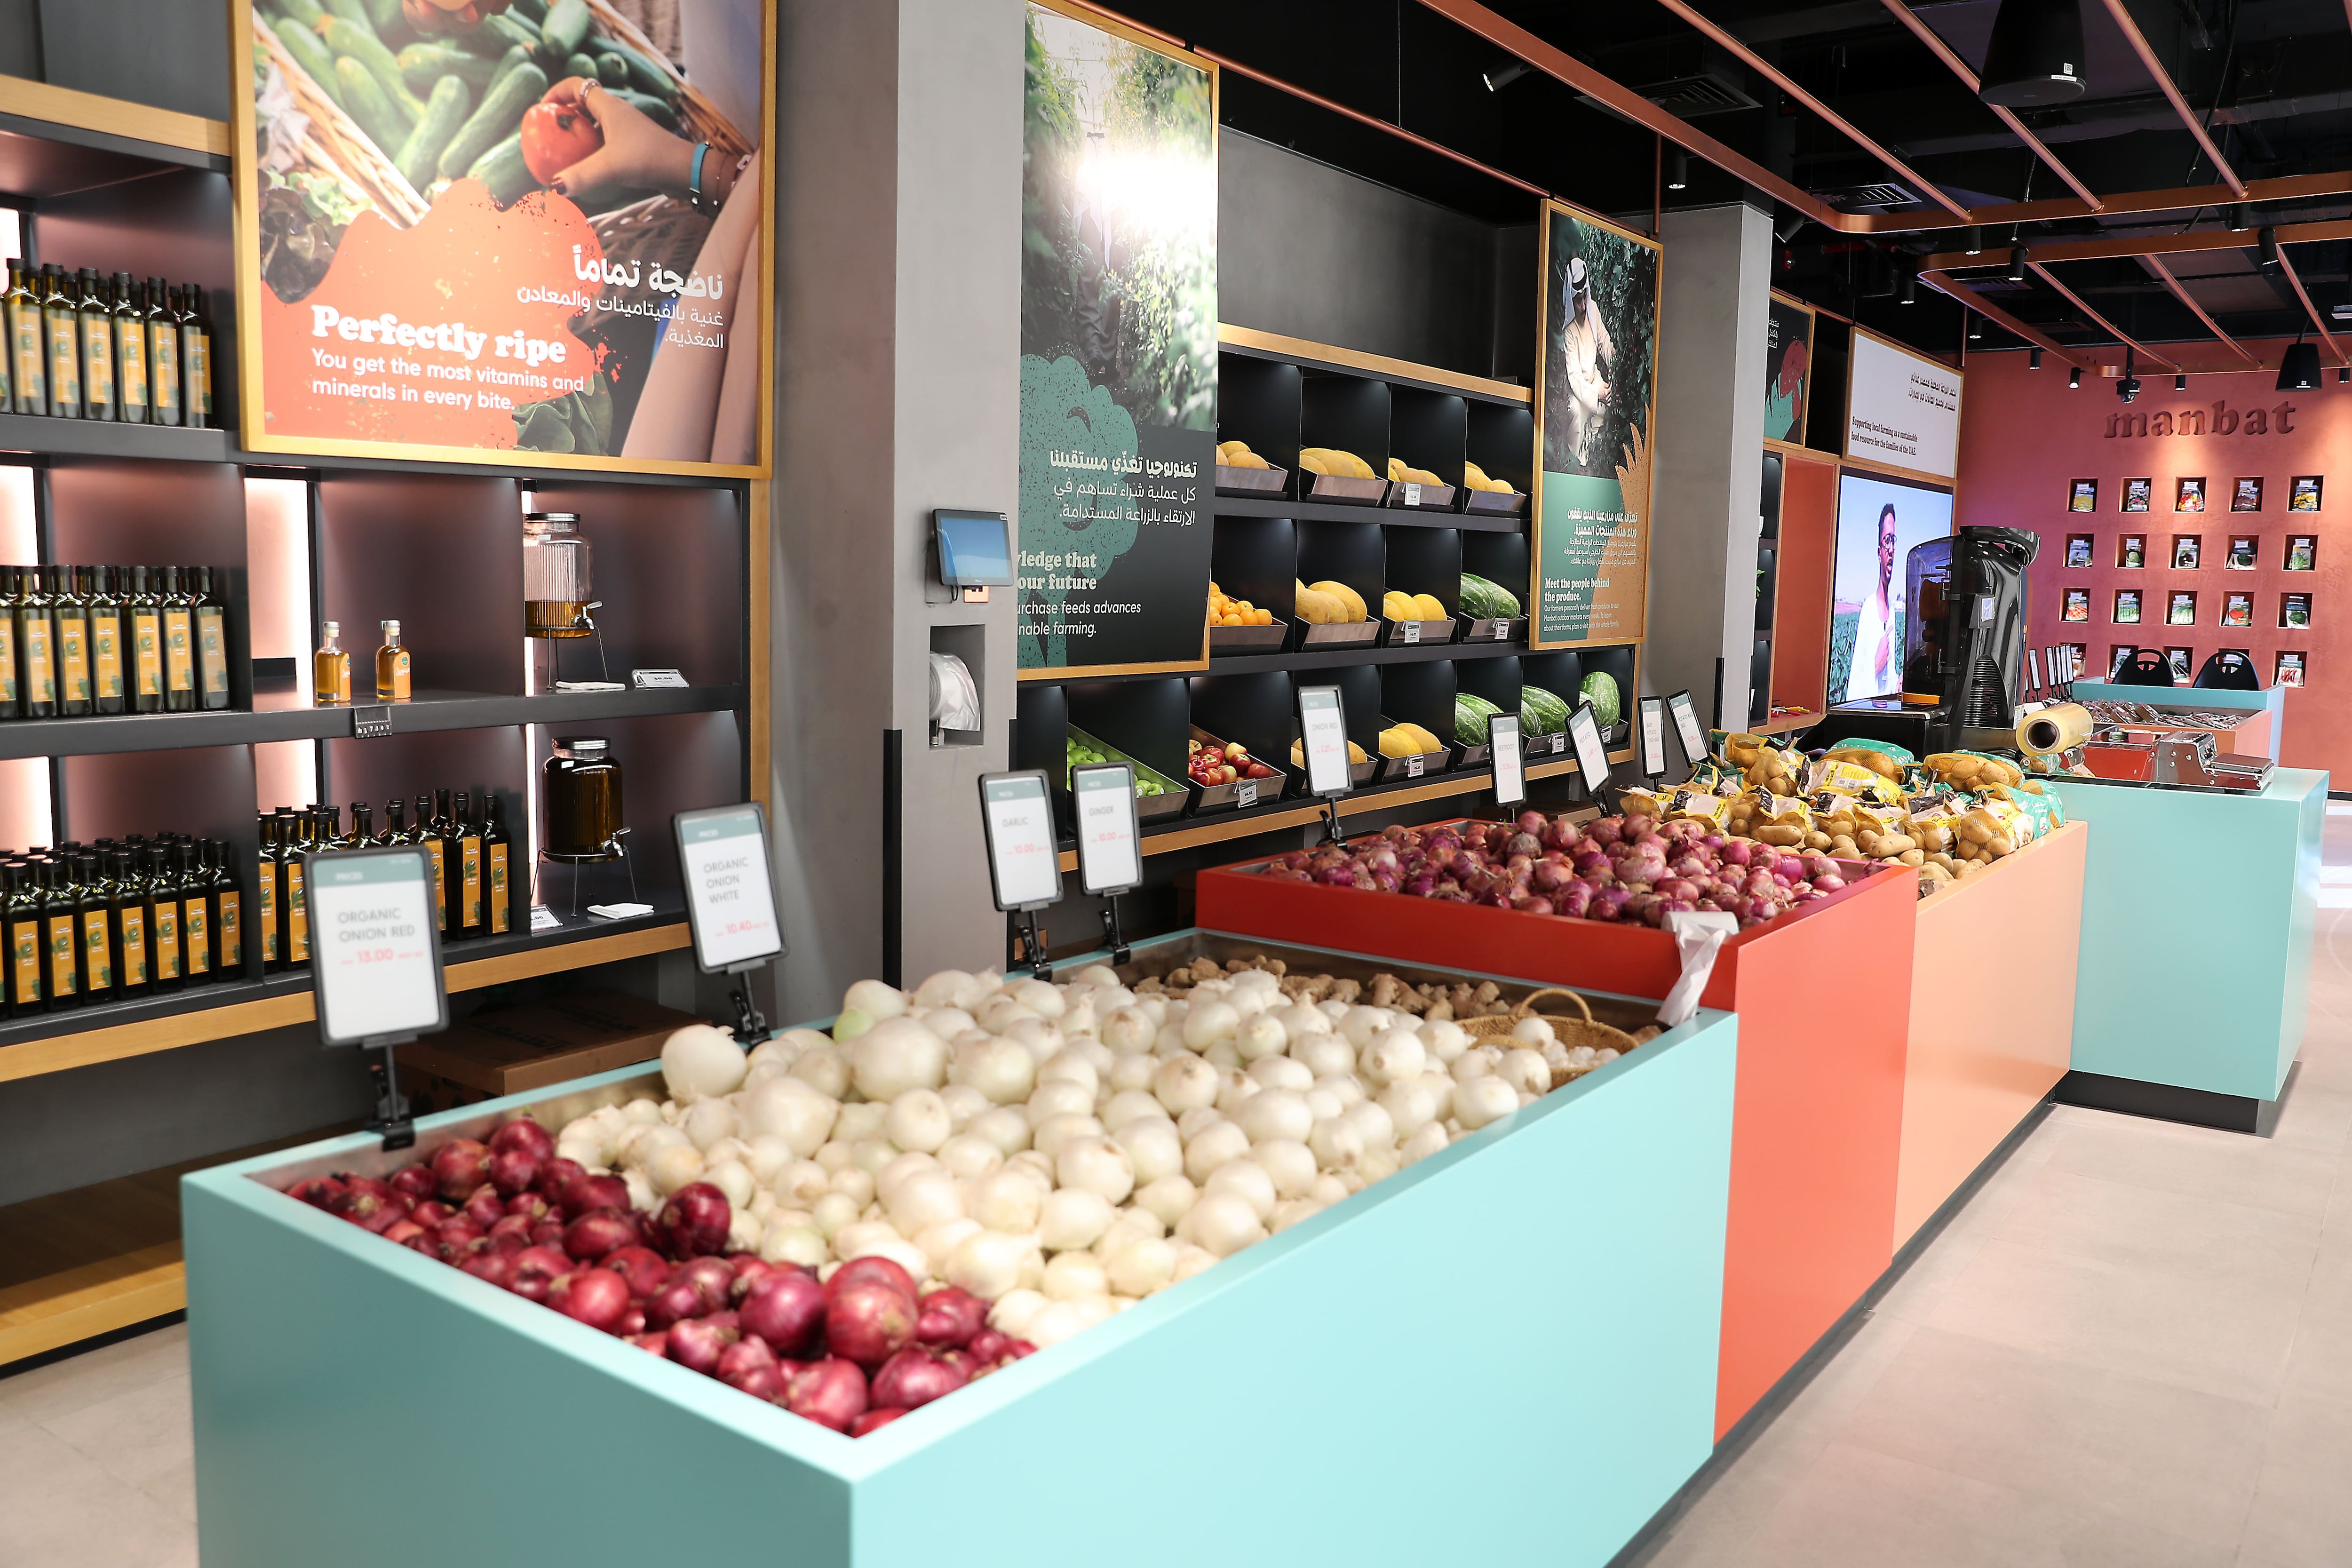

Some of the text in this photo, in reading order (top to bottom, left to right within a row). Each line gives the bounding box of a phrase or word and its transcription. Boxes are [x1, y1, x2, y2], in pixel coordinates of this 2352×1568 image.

[649, 261, 723, 300] ناضجة
[517, 286, 723, 327] غنية بالفيتامينات والمعادن
[311, 304, 566, 366] Perfectly ripe
[665, 328, 723, 348] المغذية.
[312, 348, 584, 392] You get the most vitamins and
[312, 378, 515, 410] minerals in every bite.
[1852, 416, 1872, 432] Supporting
[1881, 424, 1893, 438] farming
[1900, 432, 1917, 442] sustainable
[2104, 400, 2296, 438] manbat
[1851, 431, 1859, 441] food
[1859, 436, 1874, 445] resource
[1886, 440, 1899, 451] families
[1050, 450, 1107, 472] مستقبلنا
[1146, 459, 1197, 479] تكنولوجيا
[1054, 478, 1196, 504] كل عملية شراء تساهم في
[1059, 503, 1196, 526] الارتقاء بالزراعة المستدامة.
[1018, 550, 1097, 571] ledge that
[1018, 574, 1097, 590] our future
[1545, 577, 1610, 590] Meet the people behind
[1062, 600, 1090, 614] feeds
[1094, 600, 1141, 613] advances
[1544, 591, 1581, 604] the produce.
[1053, 621, 1097, 637] farming.
[1579, 732, 1591, 744] POTATO
[1089, 806, 1114, 816] GINGER
[1002, 817, 1029, 827] GARLIC
[705, 857, 749, 873] ORGANIC
[707, 875, 740, 889] ONION
[709, 890, 740, 904] WHITE
[338, 907, 401, 923] ORGANIC
[339, 924, 415, 942] ONION RED
